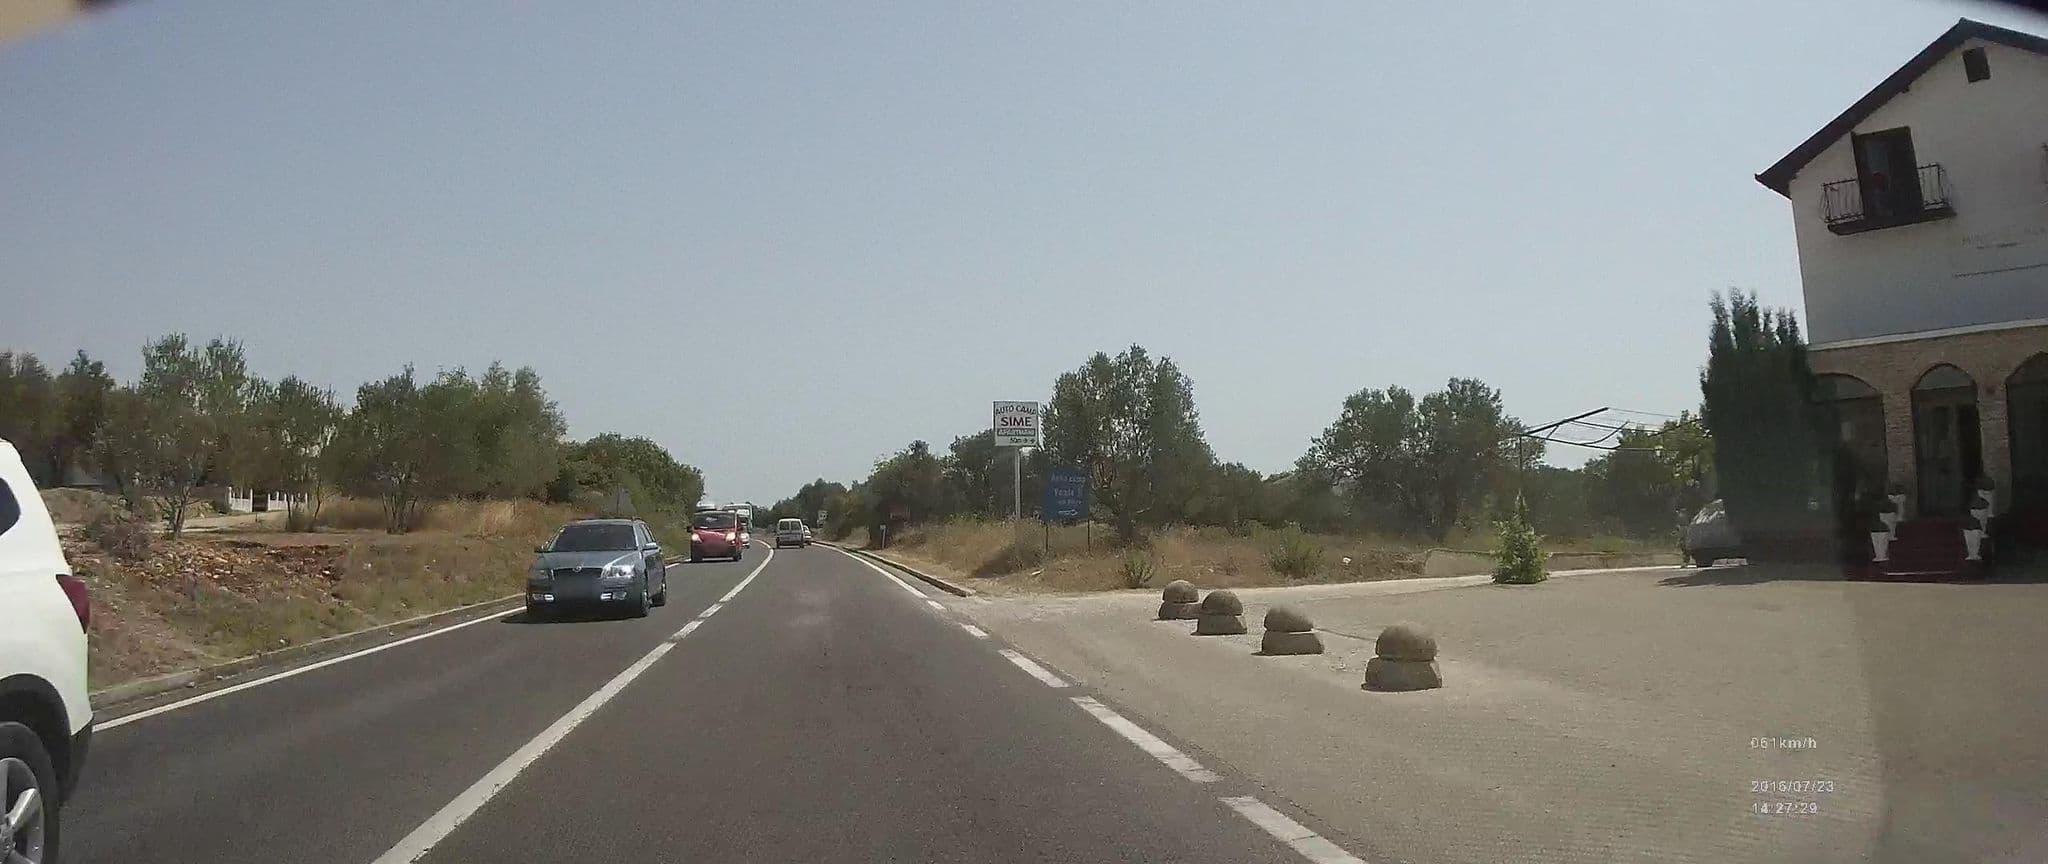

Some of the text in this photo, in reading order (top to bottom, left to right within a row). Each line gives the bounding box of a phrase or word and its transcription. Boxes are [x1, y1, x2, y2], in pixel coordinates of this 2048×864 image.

[995, 404, 1037, 416] AUTO CAMP
[1000, 416, 1032, 427] SIME
